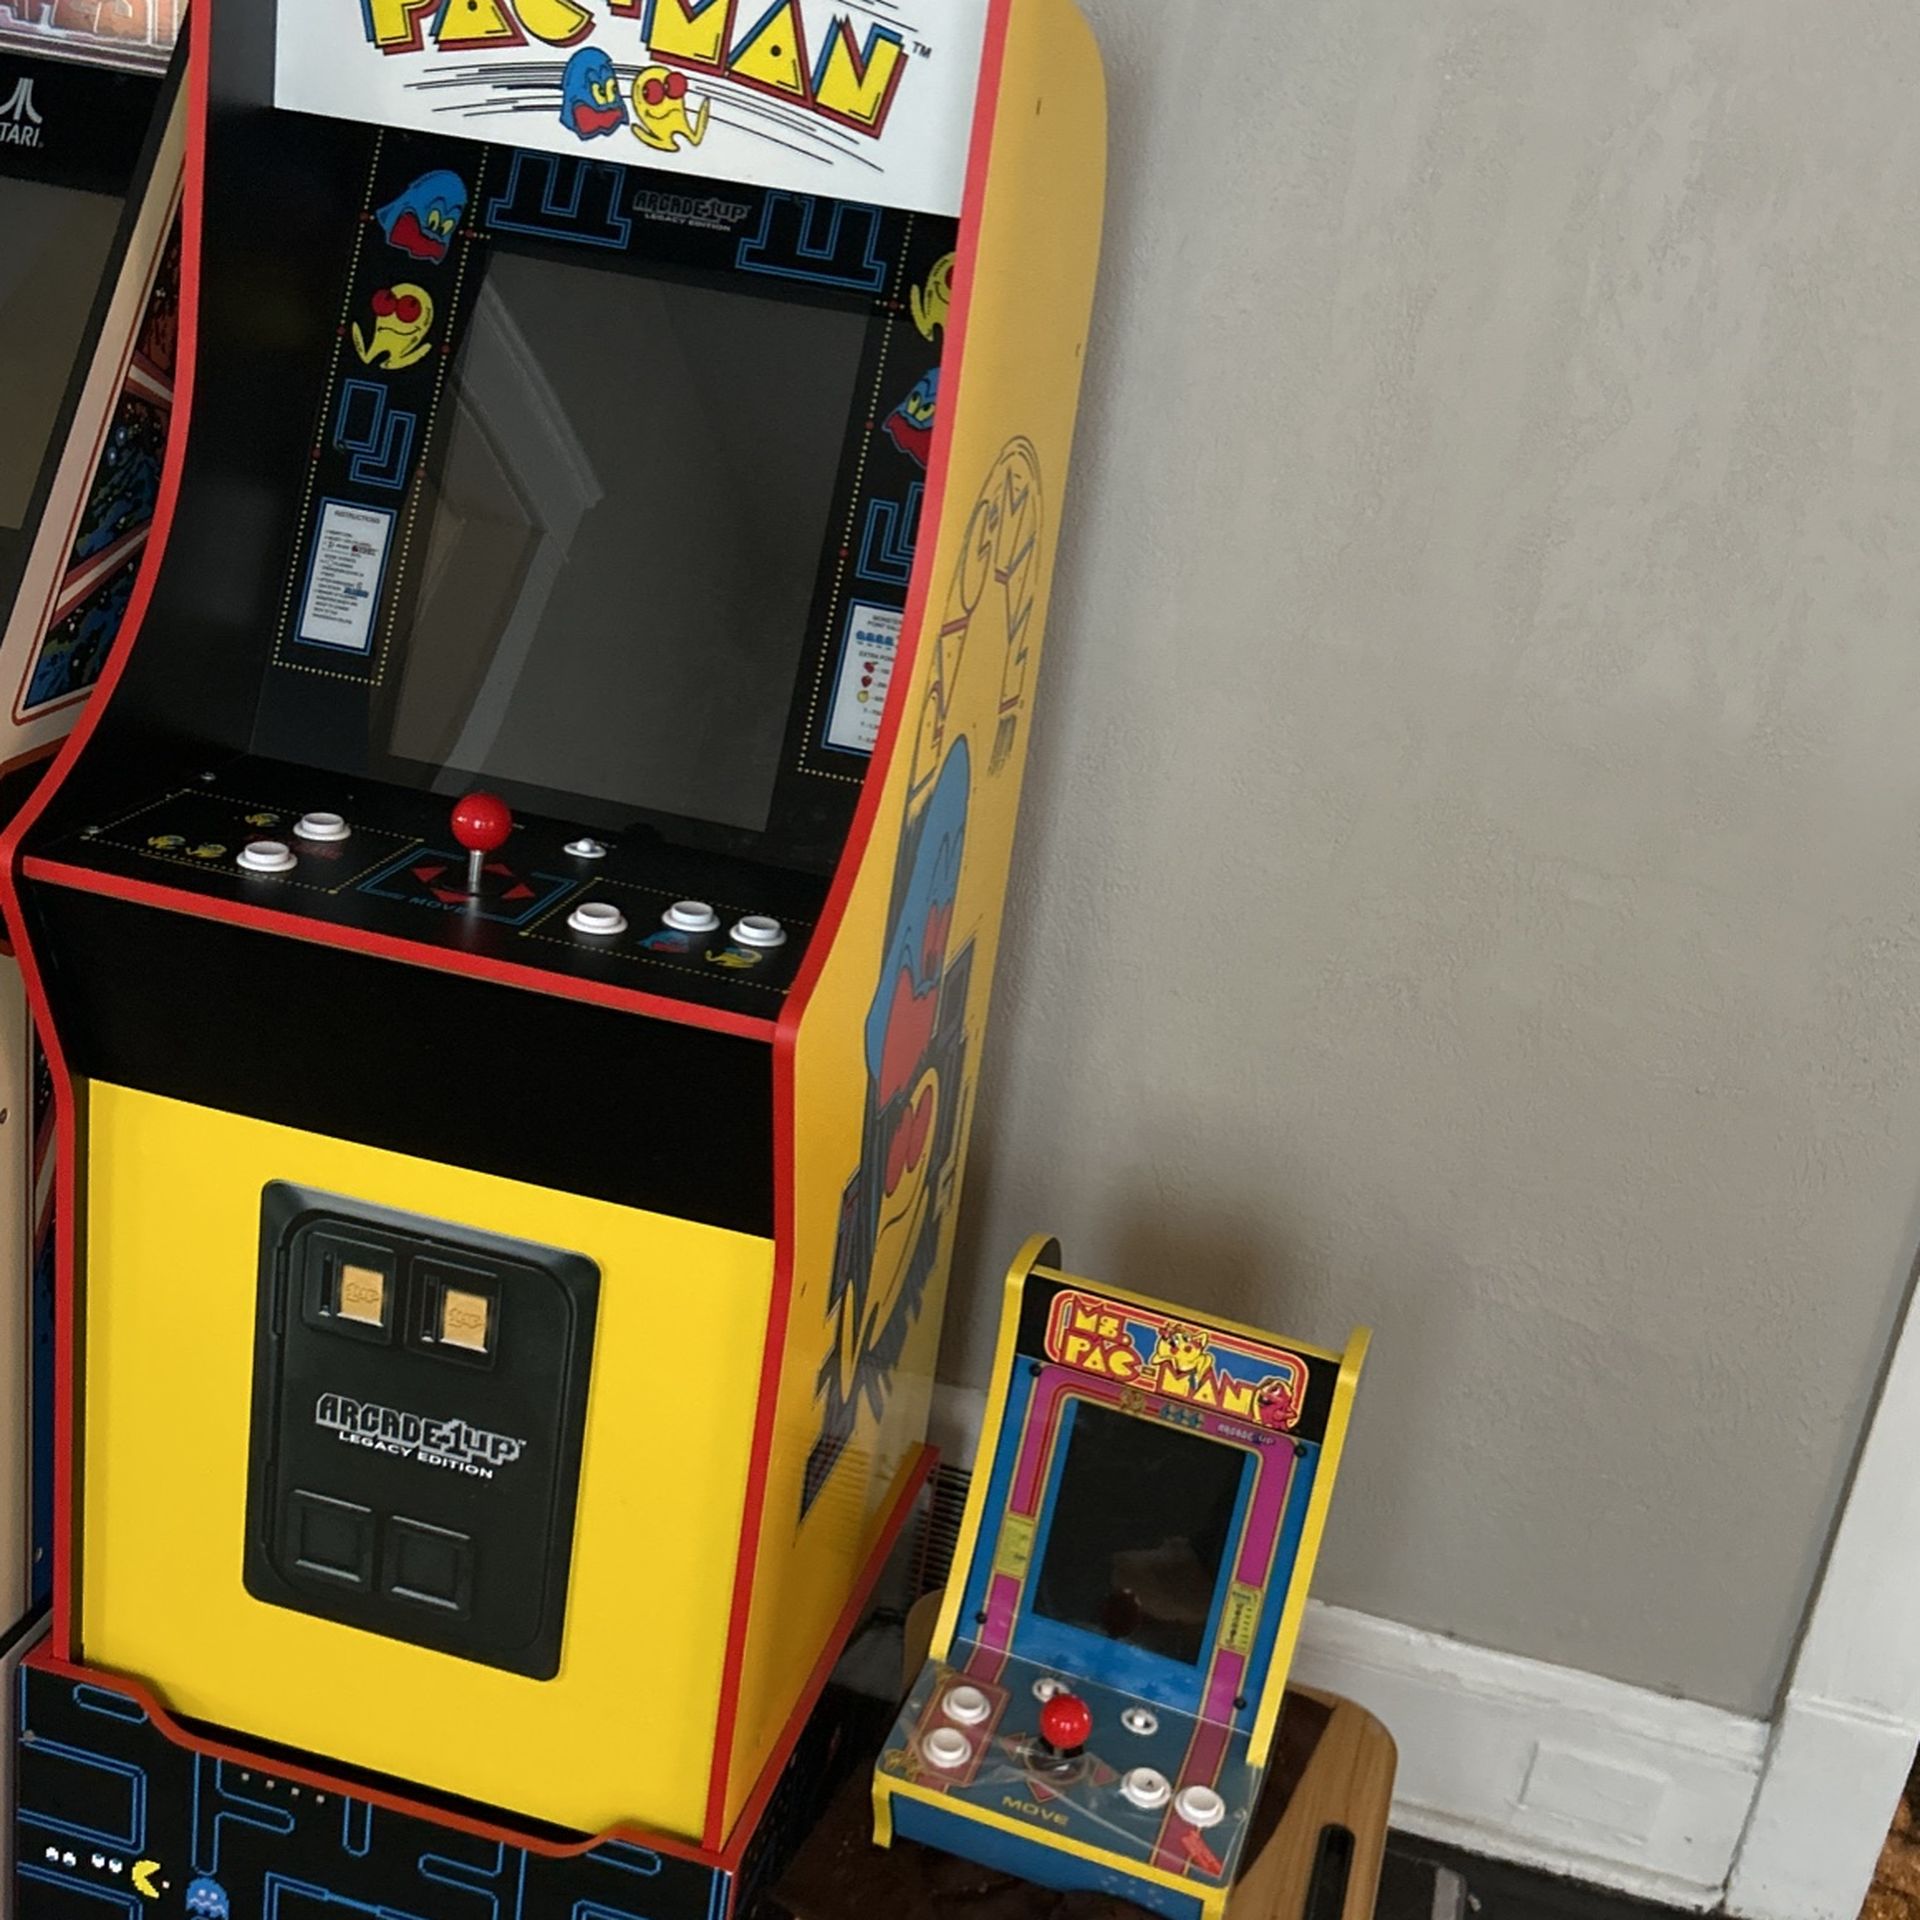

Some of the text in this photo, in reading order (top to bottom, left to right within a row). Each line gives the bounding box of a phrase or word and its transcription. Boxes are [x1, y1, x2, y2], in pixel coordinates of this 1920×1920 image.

[0, 122, 41, 147] TARI
[1070, 1302, 1132, 1347] MS.
[1062, 1336, 1254, 1415] PAC-MAN
[338, 1430, 493, 1479] LEGACY EDITION
[1002, 1795, 1069, 1826] MOVE
